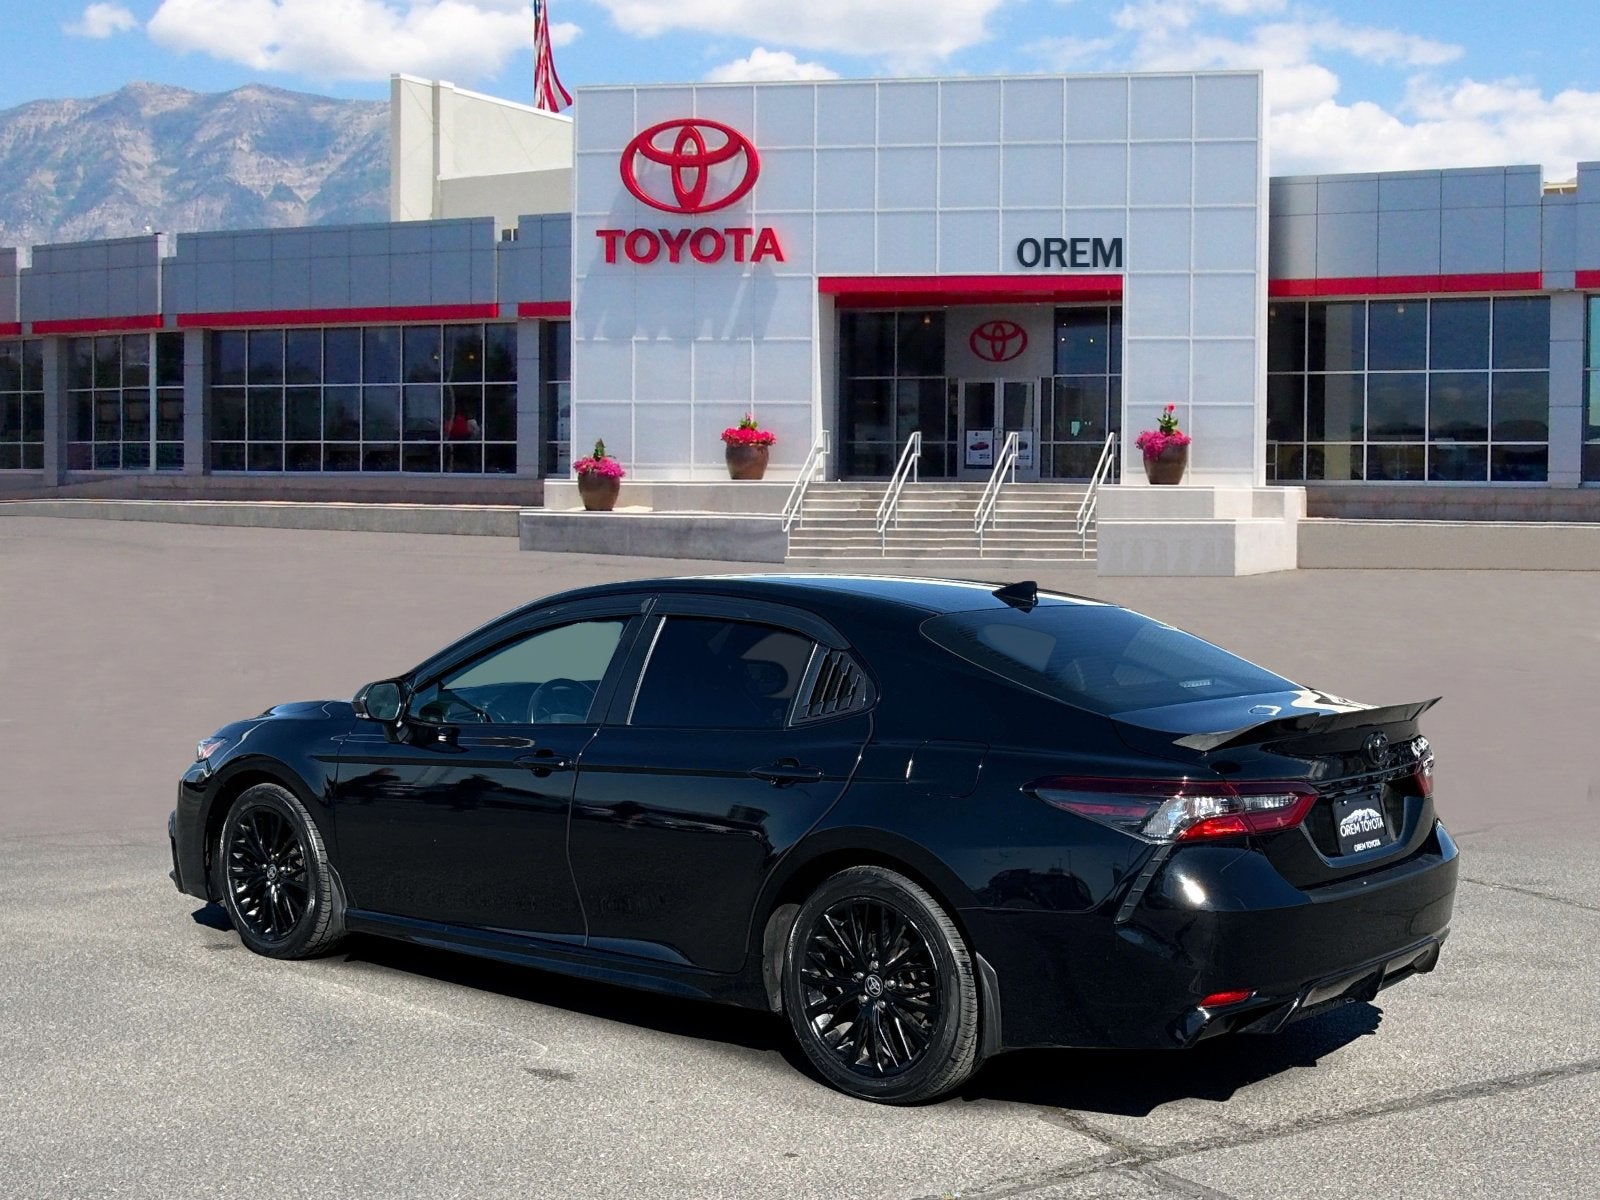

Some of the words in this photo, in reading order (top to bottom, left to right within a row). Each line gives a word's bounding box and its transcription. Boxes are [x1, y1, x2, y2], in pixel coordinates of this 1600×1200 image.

[596, 227, 784, 264] TOYOTA
[1017, 238, 1123, 268] OREM
[1340, 822, 1361, 837] OREM
[1360, 817, 1385, 832] TOYOTA
